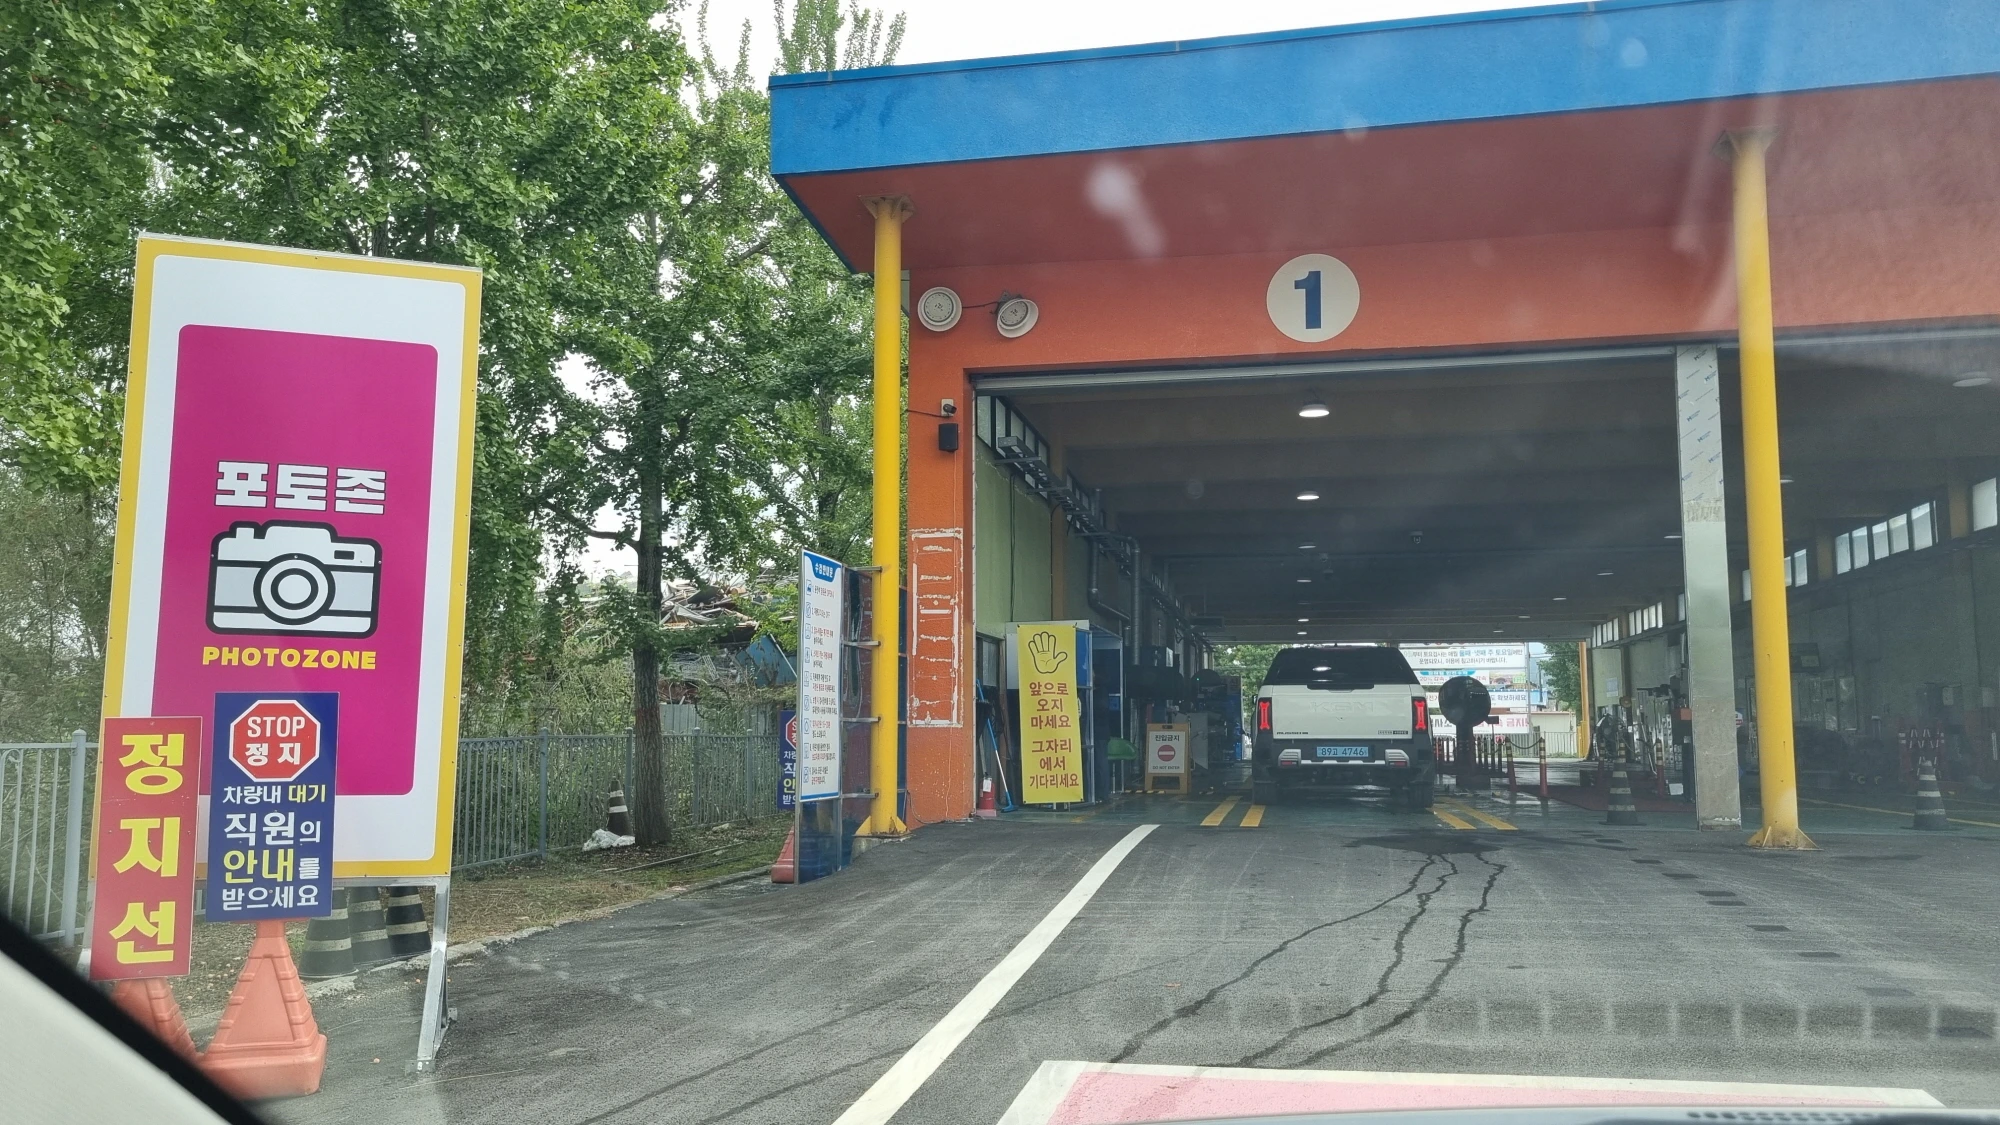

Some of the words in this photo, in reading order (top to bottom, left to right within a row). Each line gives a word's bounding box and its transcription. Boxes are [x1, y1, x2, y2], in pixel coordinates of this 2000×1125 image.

[1294, 270, 1322, 329] 1
[214, 460, 386, 515] 포토존
[202, 646, 376, 670] PHOTOZONE
[1029, 681, 1069, 697] 앞으로
[1036, 698, 1064, 713] 오지
[247, 715, 306, 738] STOP
[1030, 715, 1071, 730] 마세요
[1031, 738, 1072, 753] 그자리
[1155, 734, 1180, 742] 진입금지
[1342, 747, 1364, 756] 4746
[1039, 756, 1067, 771] 에서
[1030, 773, 1080, 789] 기다리세요
[222, 784, 281, 805] 차량내
[288, 784, 327, 804] 대기
[223, 810, 321, 846] 직원의
[108, 733, 185, 964] 정지선
[223, 847, 321, 884] 안내를
[222, 884, 319, 912] 받으세요
